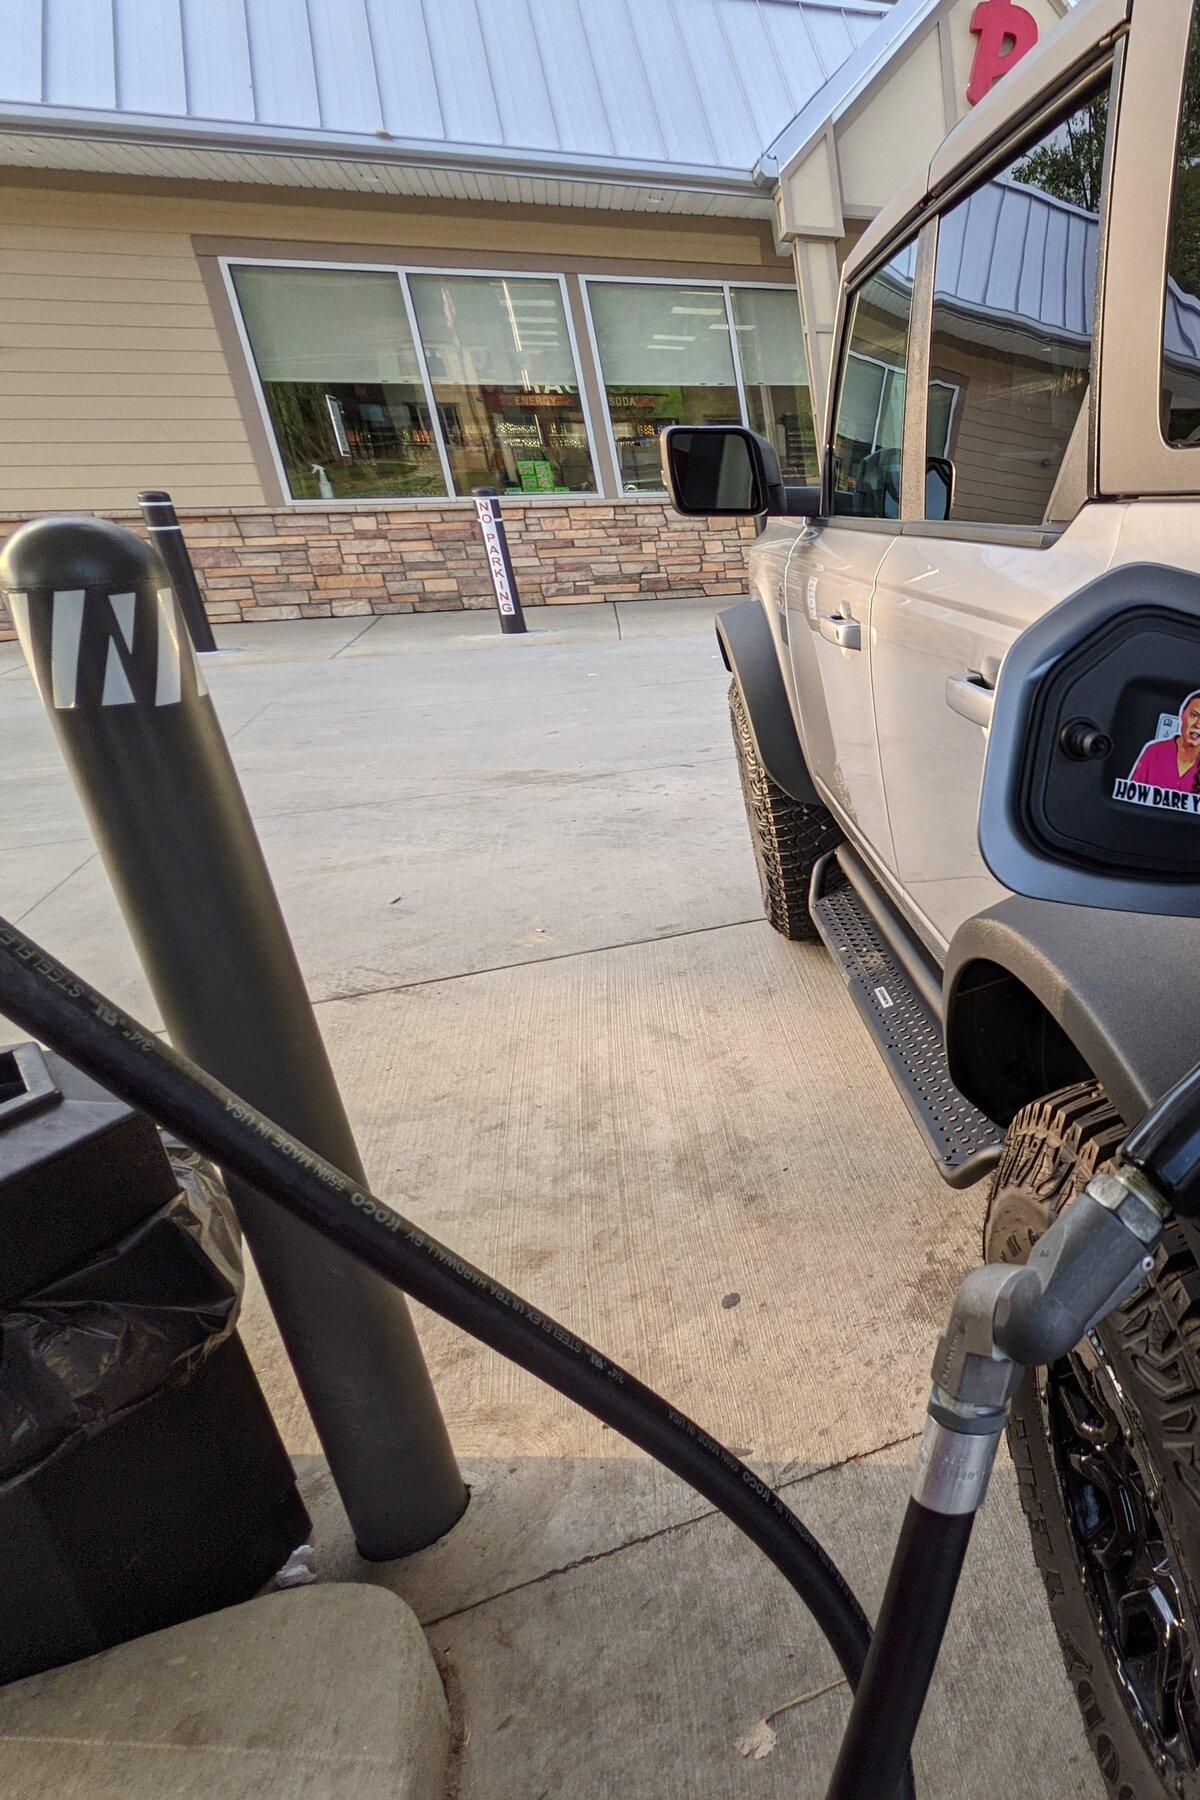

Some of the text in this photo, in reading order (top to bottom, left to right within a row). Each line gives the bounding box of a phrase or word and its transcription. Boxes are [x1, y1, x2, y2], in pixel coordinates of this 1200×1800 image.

[514, 396, 557, 406] ENERGY
[608, 396, 637, 407] SODA
[478, 501, 513, 613] NO PARKING
[1114, 780, 1151, 803] HOW
[1153, 788, 1189, 811] DARE
[225, 1099, 256, 1126] USA
[271, 1137, 314, 1168] MADE
[490, 1284, 525, 1314] ULTRA
[525, 1308, 583, 1353] STEELFLEX
